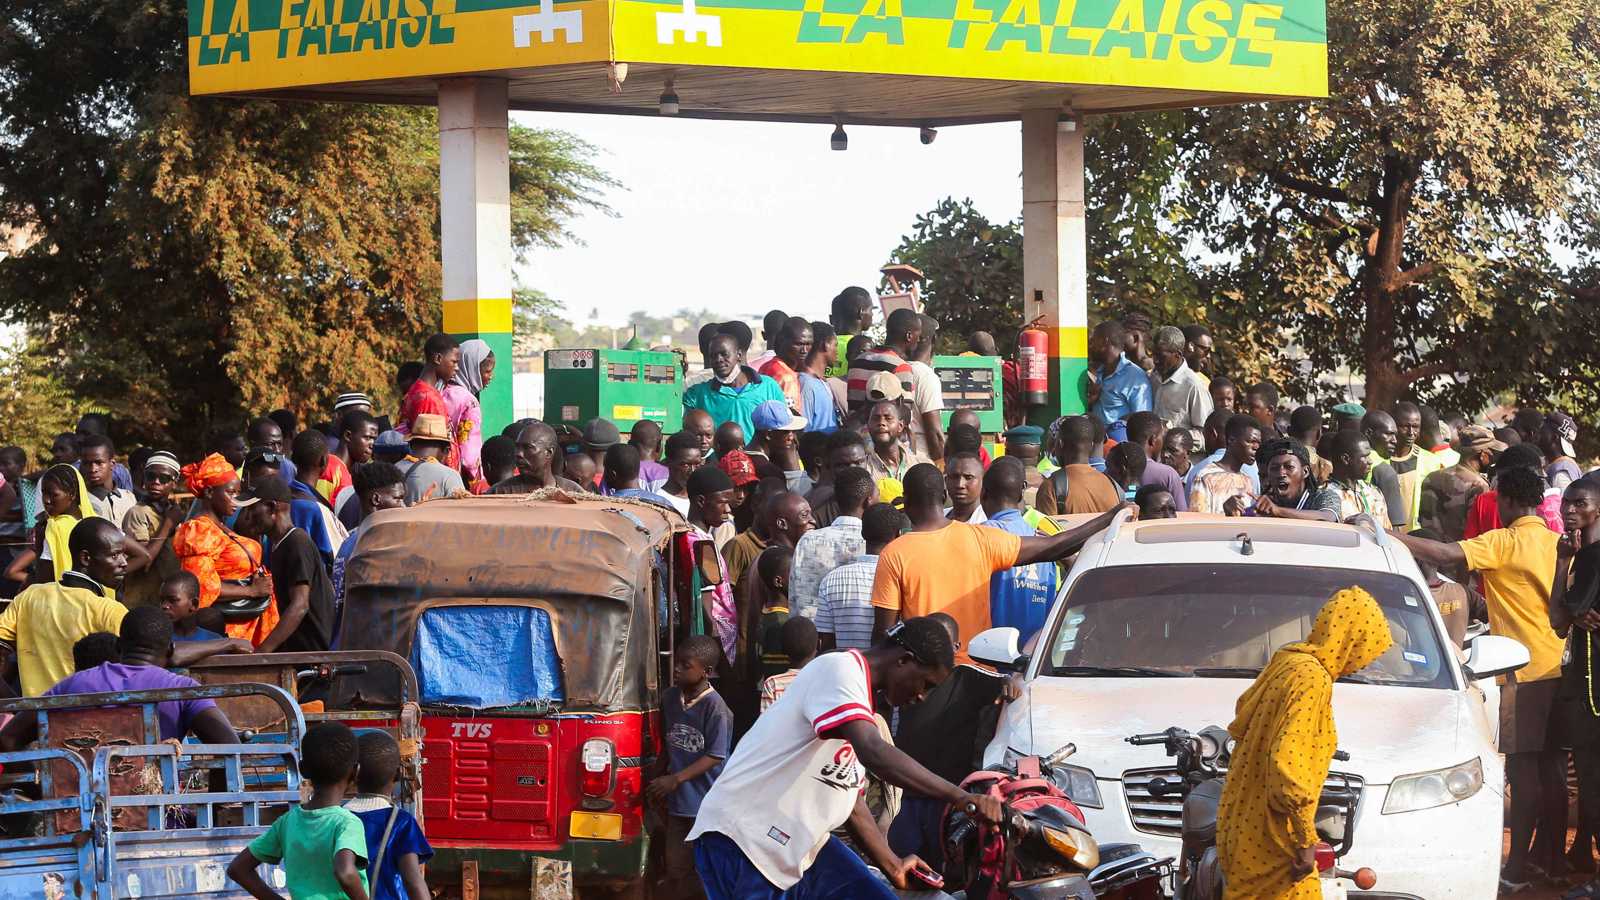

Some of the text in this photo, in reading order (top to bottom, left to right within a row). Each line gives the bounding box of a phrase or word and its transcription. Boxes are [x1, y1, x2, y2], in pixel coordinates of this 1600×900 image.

[198, 0, 456, 66] LA FALAISE
[796, 0, 1284, 68] LA FALAISE
[451, 721, 493, 738] TVS
